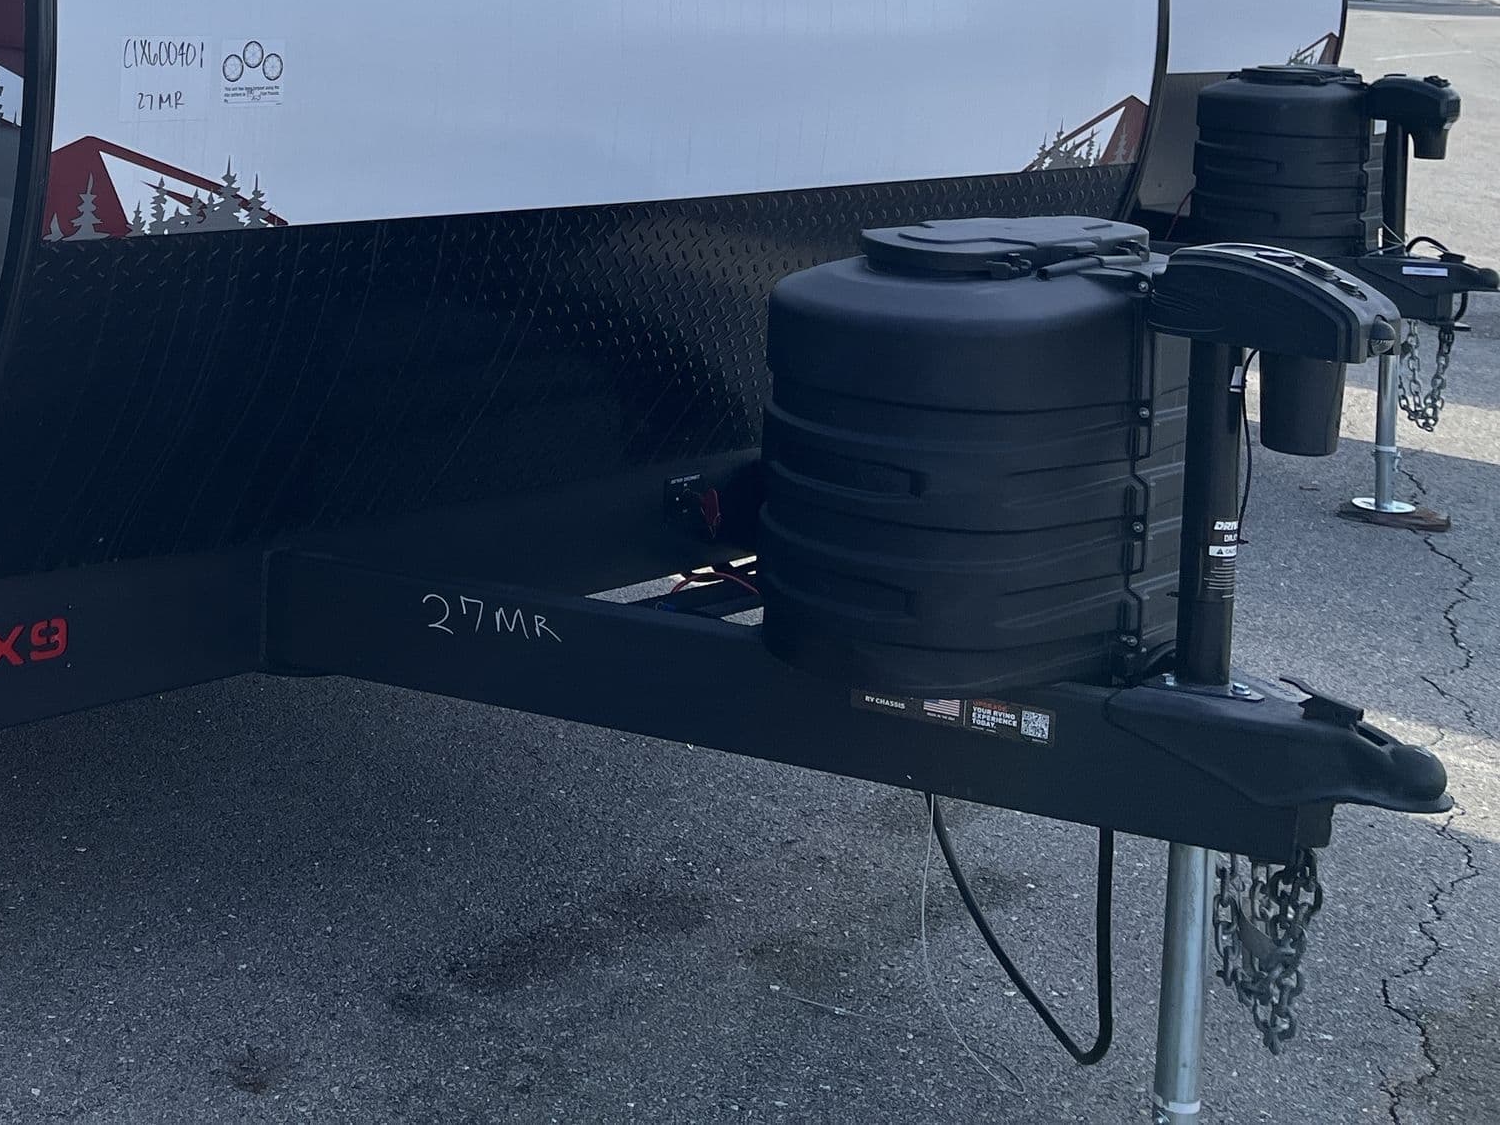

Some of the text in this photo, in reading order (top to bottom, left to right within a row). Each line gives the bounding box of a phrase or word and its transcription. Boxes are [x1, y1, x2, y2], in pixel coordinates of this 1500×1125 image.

[864, 695, 906, 709] RV CHASSIS
[973, 706, 992, 716] YOUR
[972, 712, 1018, 727] EXPERIENCE
